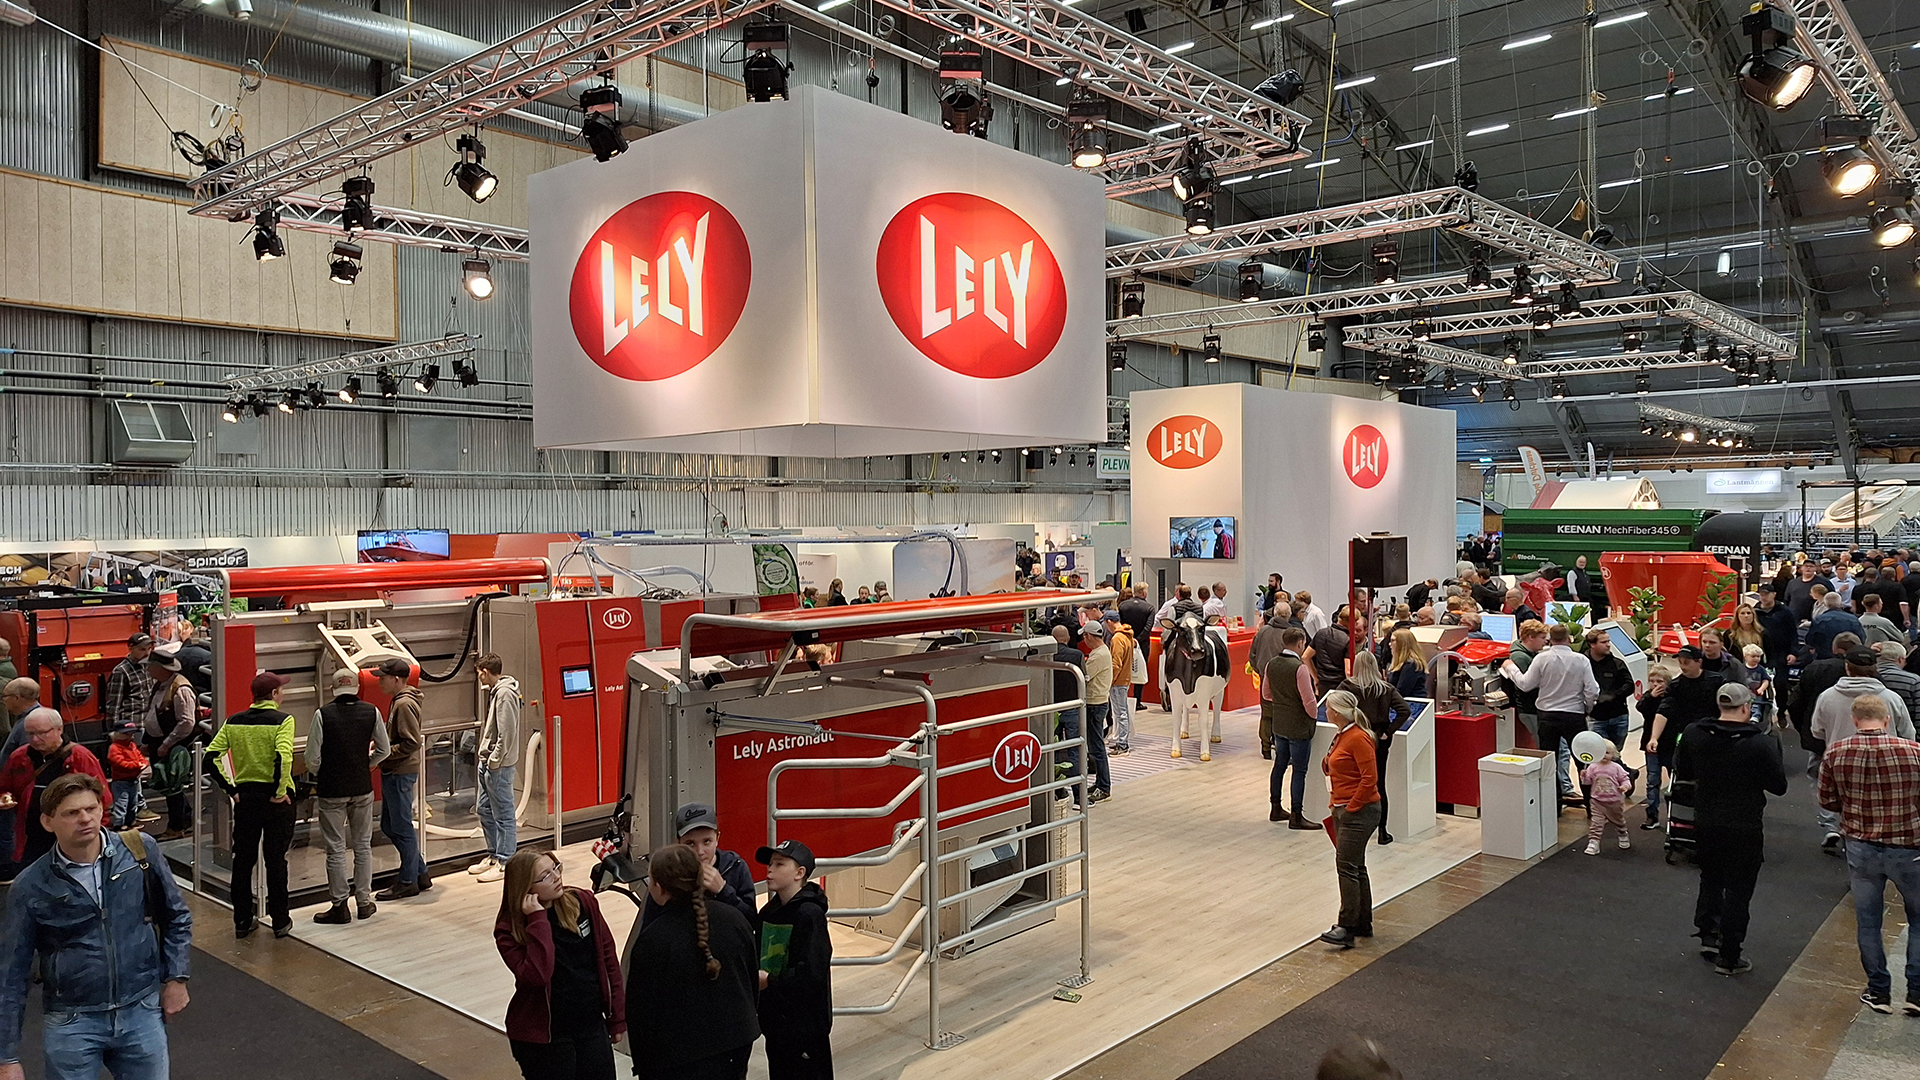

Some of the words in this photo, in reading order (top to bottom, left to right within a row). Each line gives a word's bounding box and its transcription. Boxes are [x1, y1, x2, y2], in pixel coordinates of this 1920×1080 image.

[600, 210, 711, 356] LELY
[919, 213, 1034, 350] LELY
[1160, 421, 1208, 462] LELY
[1351, 434, 1381, 479] LELY
[1727, 478, 1774, 486] Lantmännen
[1557, 525, 1601, 534] KEENAN
[1603, 525, 1670, 536] MechFiber345
[1703, 545, 1751, 556] KEENAN
[188, 553, 243, 568] spinder
[562, 577, 573, 586] tks
[608, 611, 626, 625] LELY
[604, 685, 615, 693] Lely
[733, 741, 763, 760] Lely
[766, 728, 835, 754] Astronaut
[1004, 739, 1034, 776] LELY
